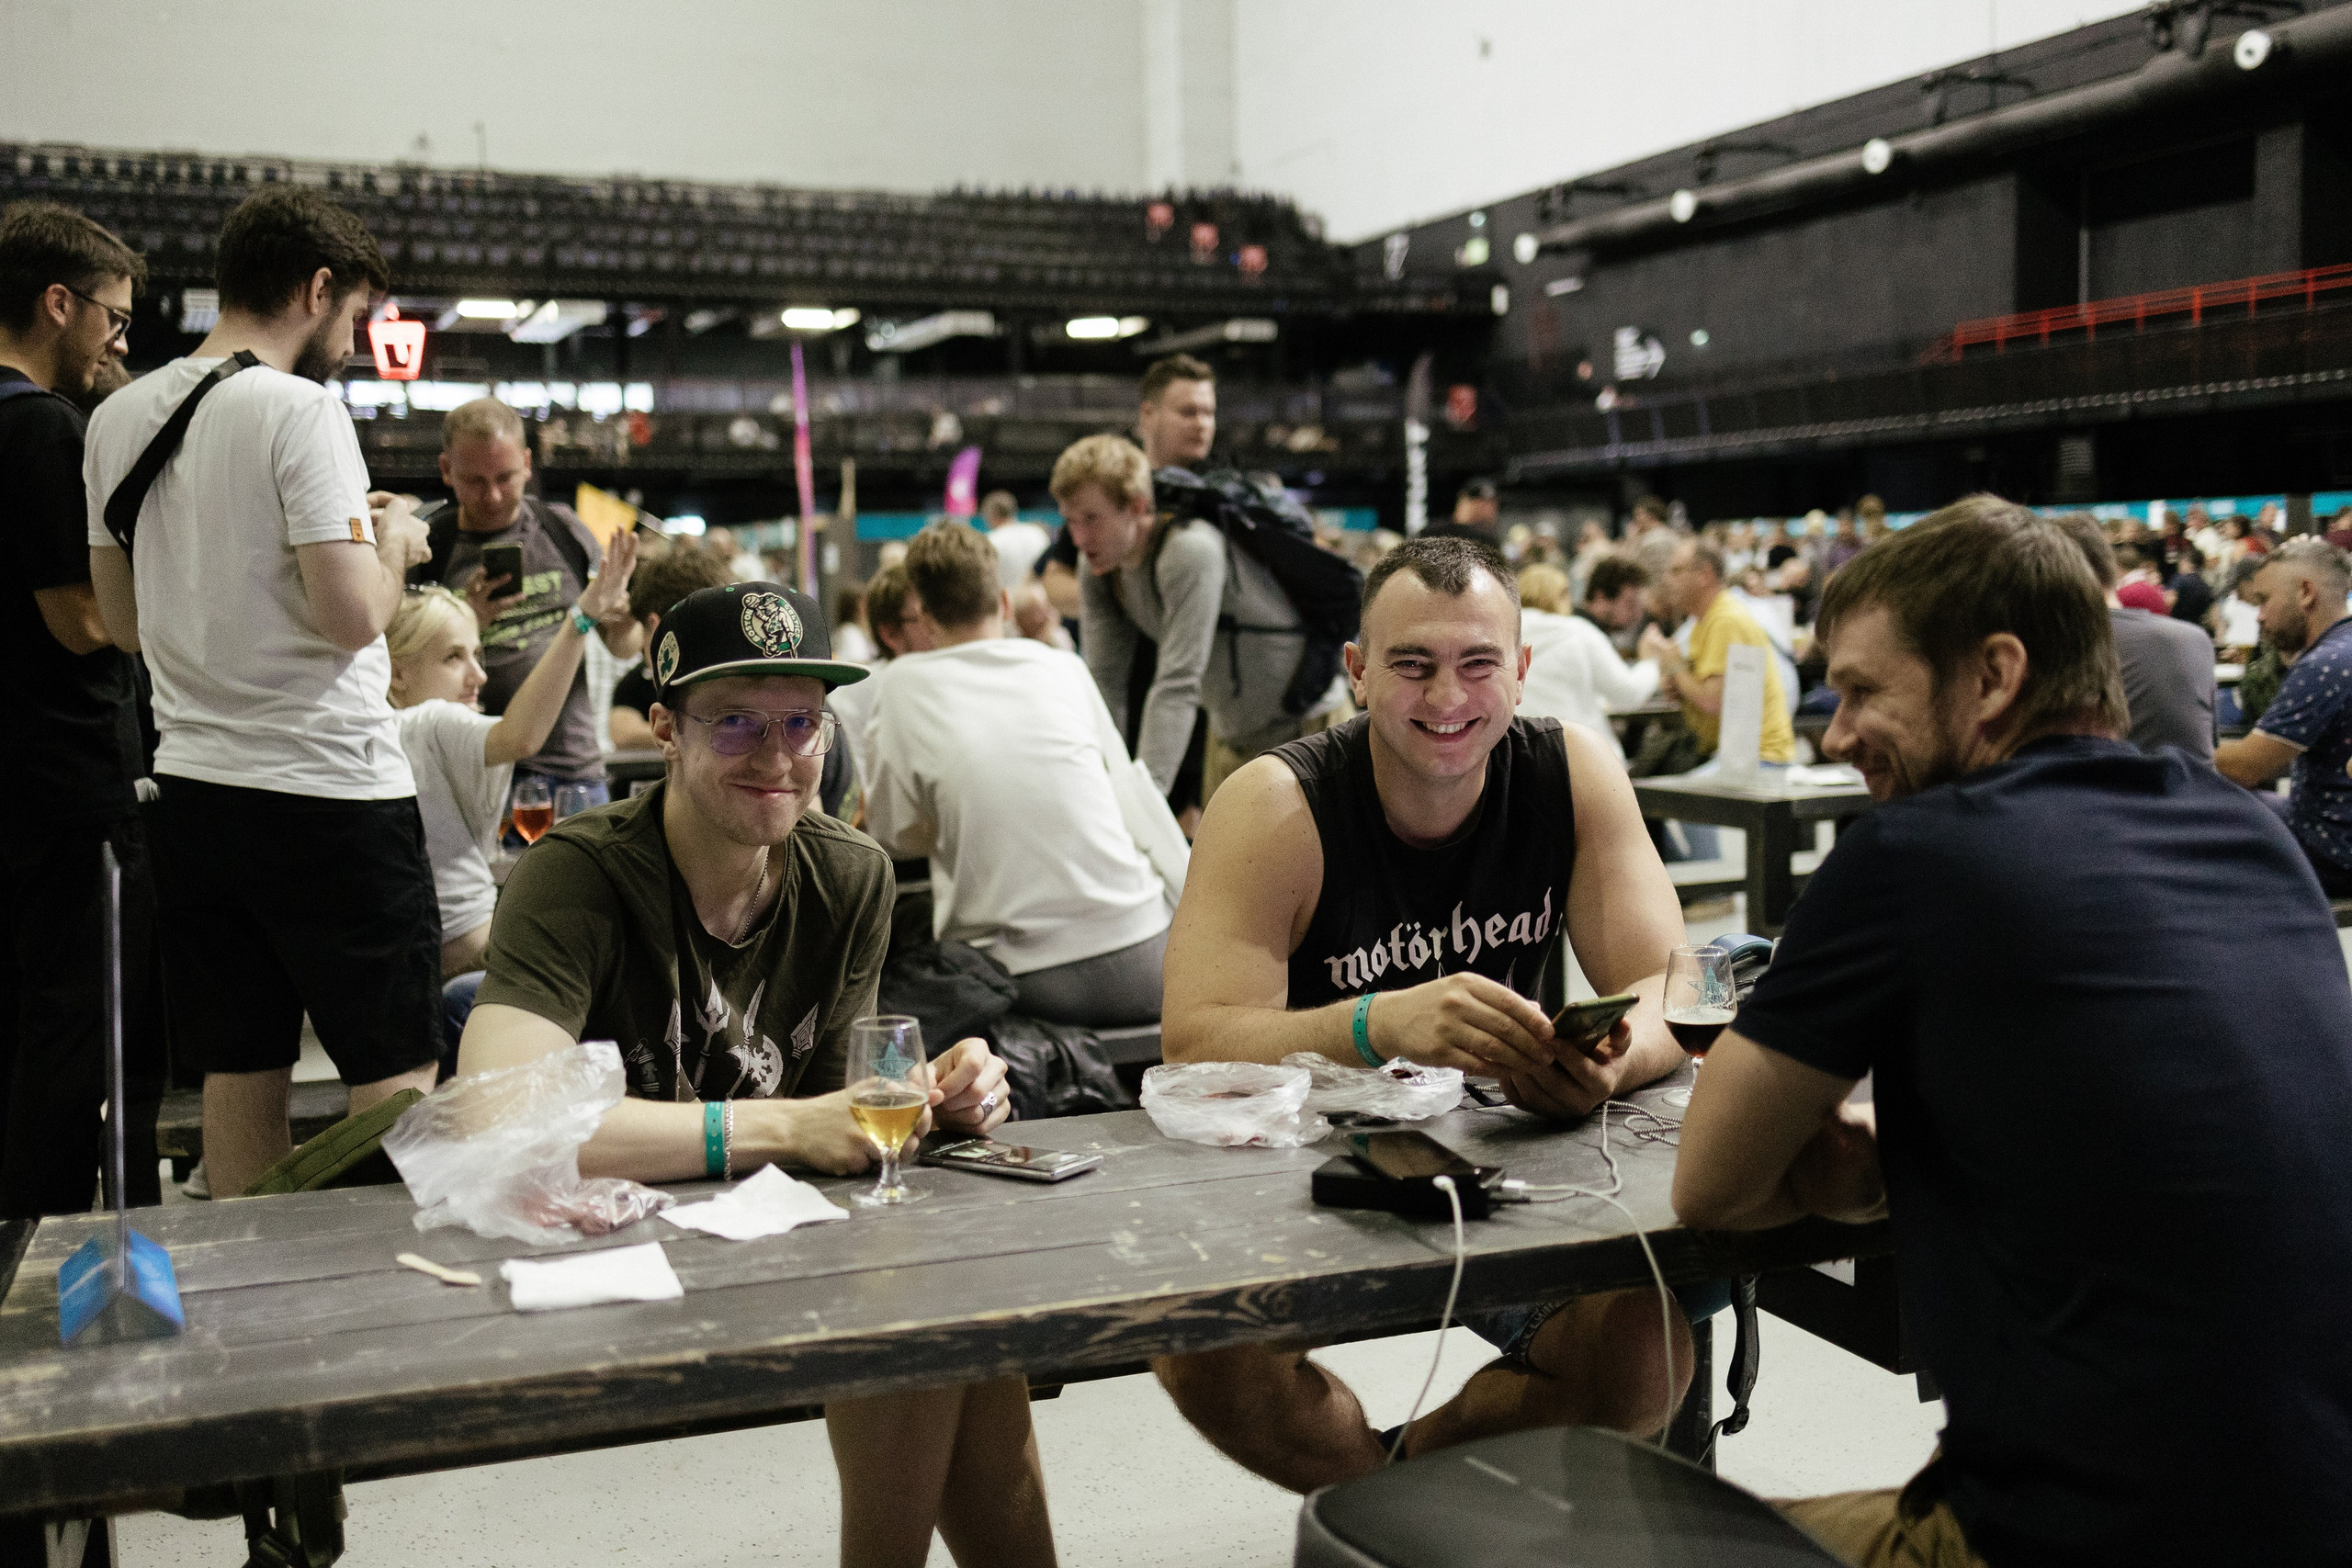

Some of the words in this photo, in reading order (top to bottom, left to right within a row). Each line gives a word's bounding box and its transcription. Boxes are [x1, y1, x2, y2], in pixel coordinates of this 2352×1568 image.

[744, 608, 761, 642] BOSTON
[784, 604, 800, 639] CELTICS
[1324, 886, 1552, 990] motörhead
